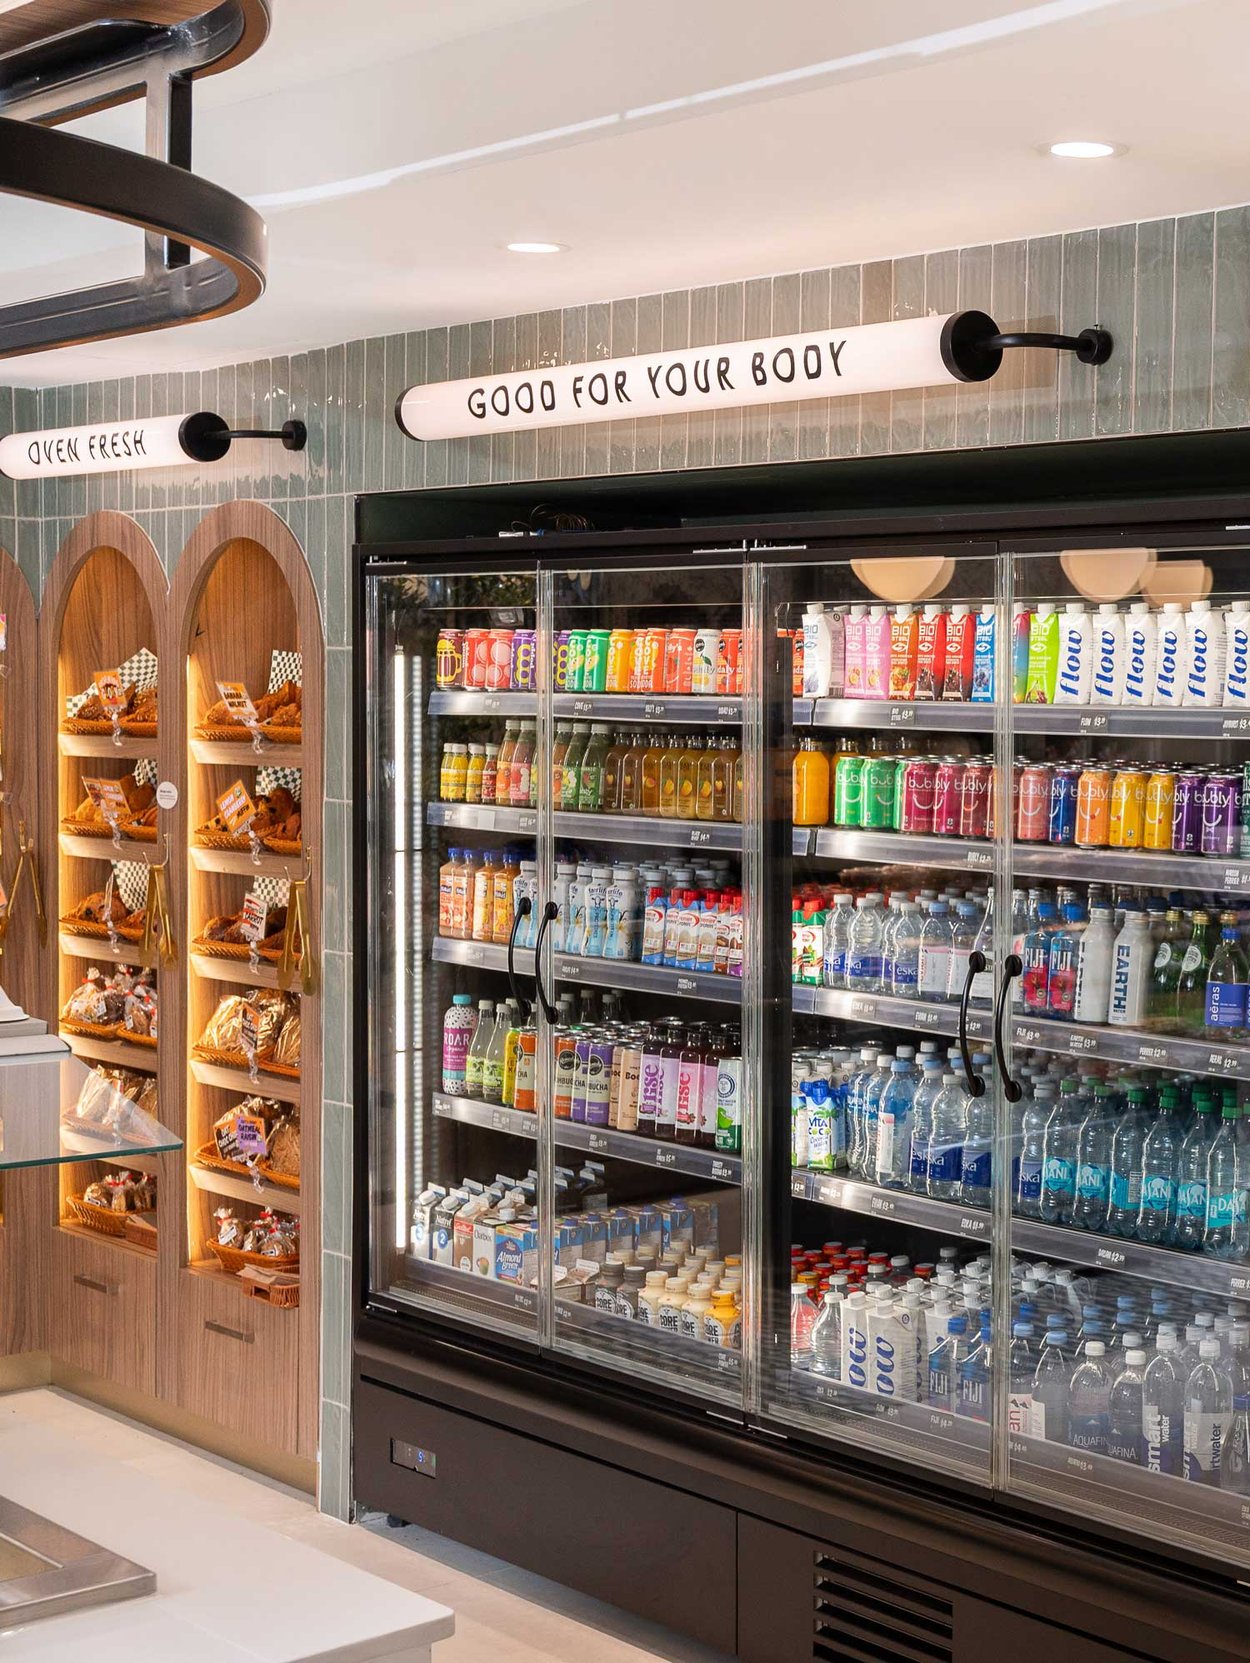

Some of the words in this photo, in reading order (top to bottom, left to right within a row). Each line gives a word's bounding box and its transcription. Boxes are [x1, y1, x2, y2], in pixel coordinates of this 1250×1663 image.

[467, 378, 556, 420] GOOD
[573, 370, 628, 409] FOR
[645, 355, 737, 399] YOUR
[752, 340, 848, 386] BODY
[28, 438, 80, 466] OVEN
[87, 428, 148, 462] FRESH
[803, 625, 818, 634] BIO
[846, 625, 861, 634] BIO
[866, 625, 881, 635] BIO
[891, 626, 910, 635] BIO
[919, 625, 934, 635] BIO
[946, 625, 962, 635] BIO
[976, 625, 992, 635] BIO
[1030, 624, 1049, 635] BIO
[1059, 629, 1084, 697] flow
[1094, 629, 1118, 697] flow
[1126, 629, 1147, 698] flow
[1156, 629, 1177, 697] flow
[1187, 628, 1208, 698] flow
[1226, 628, 1250, 699] flow
[1026, 947, 1045, 970] FIJI
[1052, 950, 1071, 971] FIJI
[897, 965, 918, 977] eska
[1115, 944, 1130, 1011] EARTH
[444, 1031, 470, 1047] ROAR
[238, 1124, 261, 1135] OATMEAL
[808, 1116, 828, 1128] VITA
[240, 1131, 258, 1141] RAISIN
[440, 1234, 446, 1246] 2
[497, 1250, 522, 1264] Almond
[660, 1314, 678, 1327] CORE
[930, 1371, 948, 1395] FIJI
[963, 1379, 982, 1404] FIJI
[1161, 1414, 1170, 1444] water
